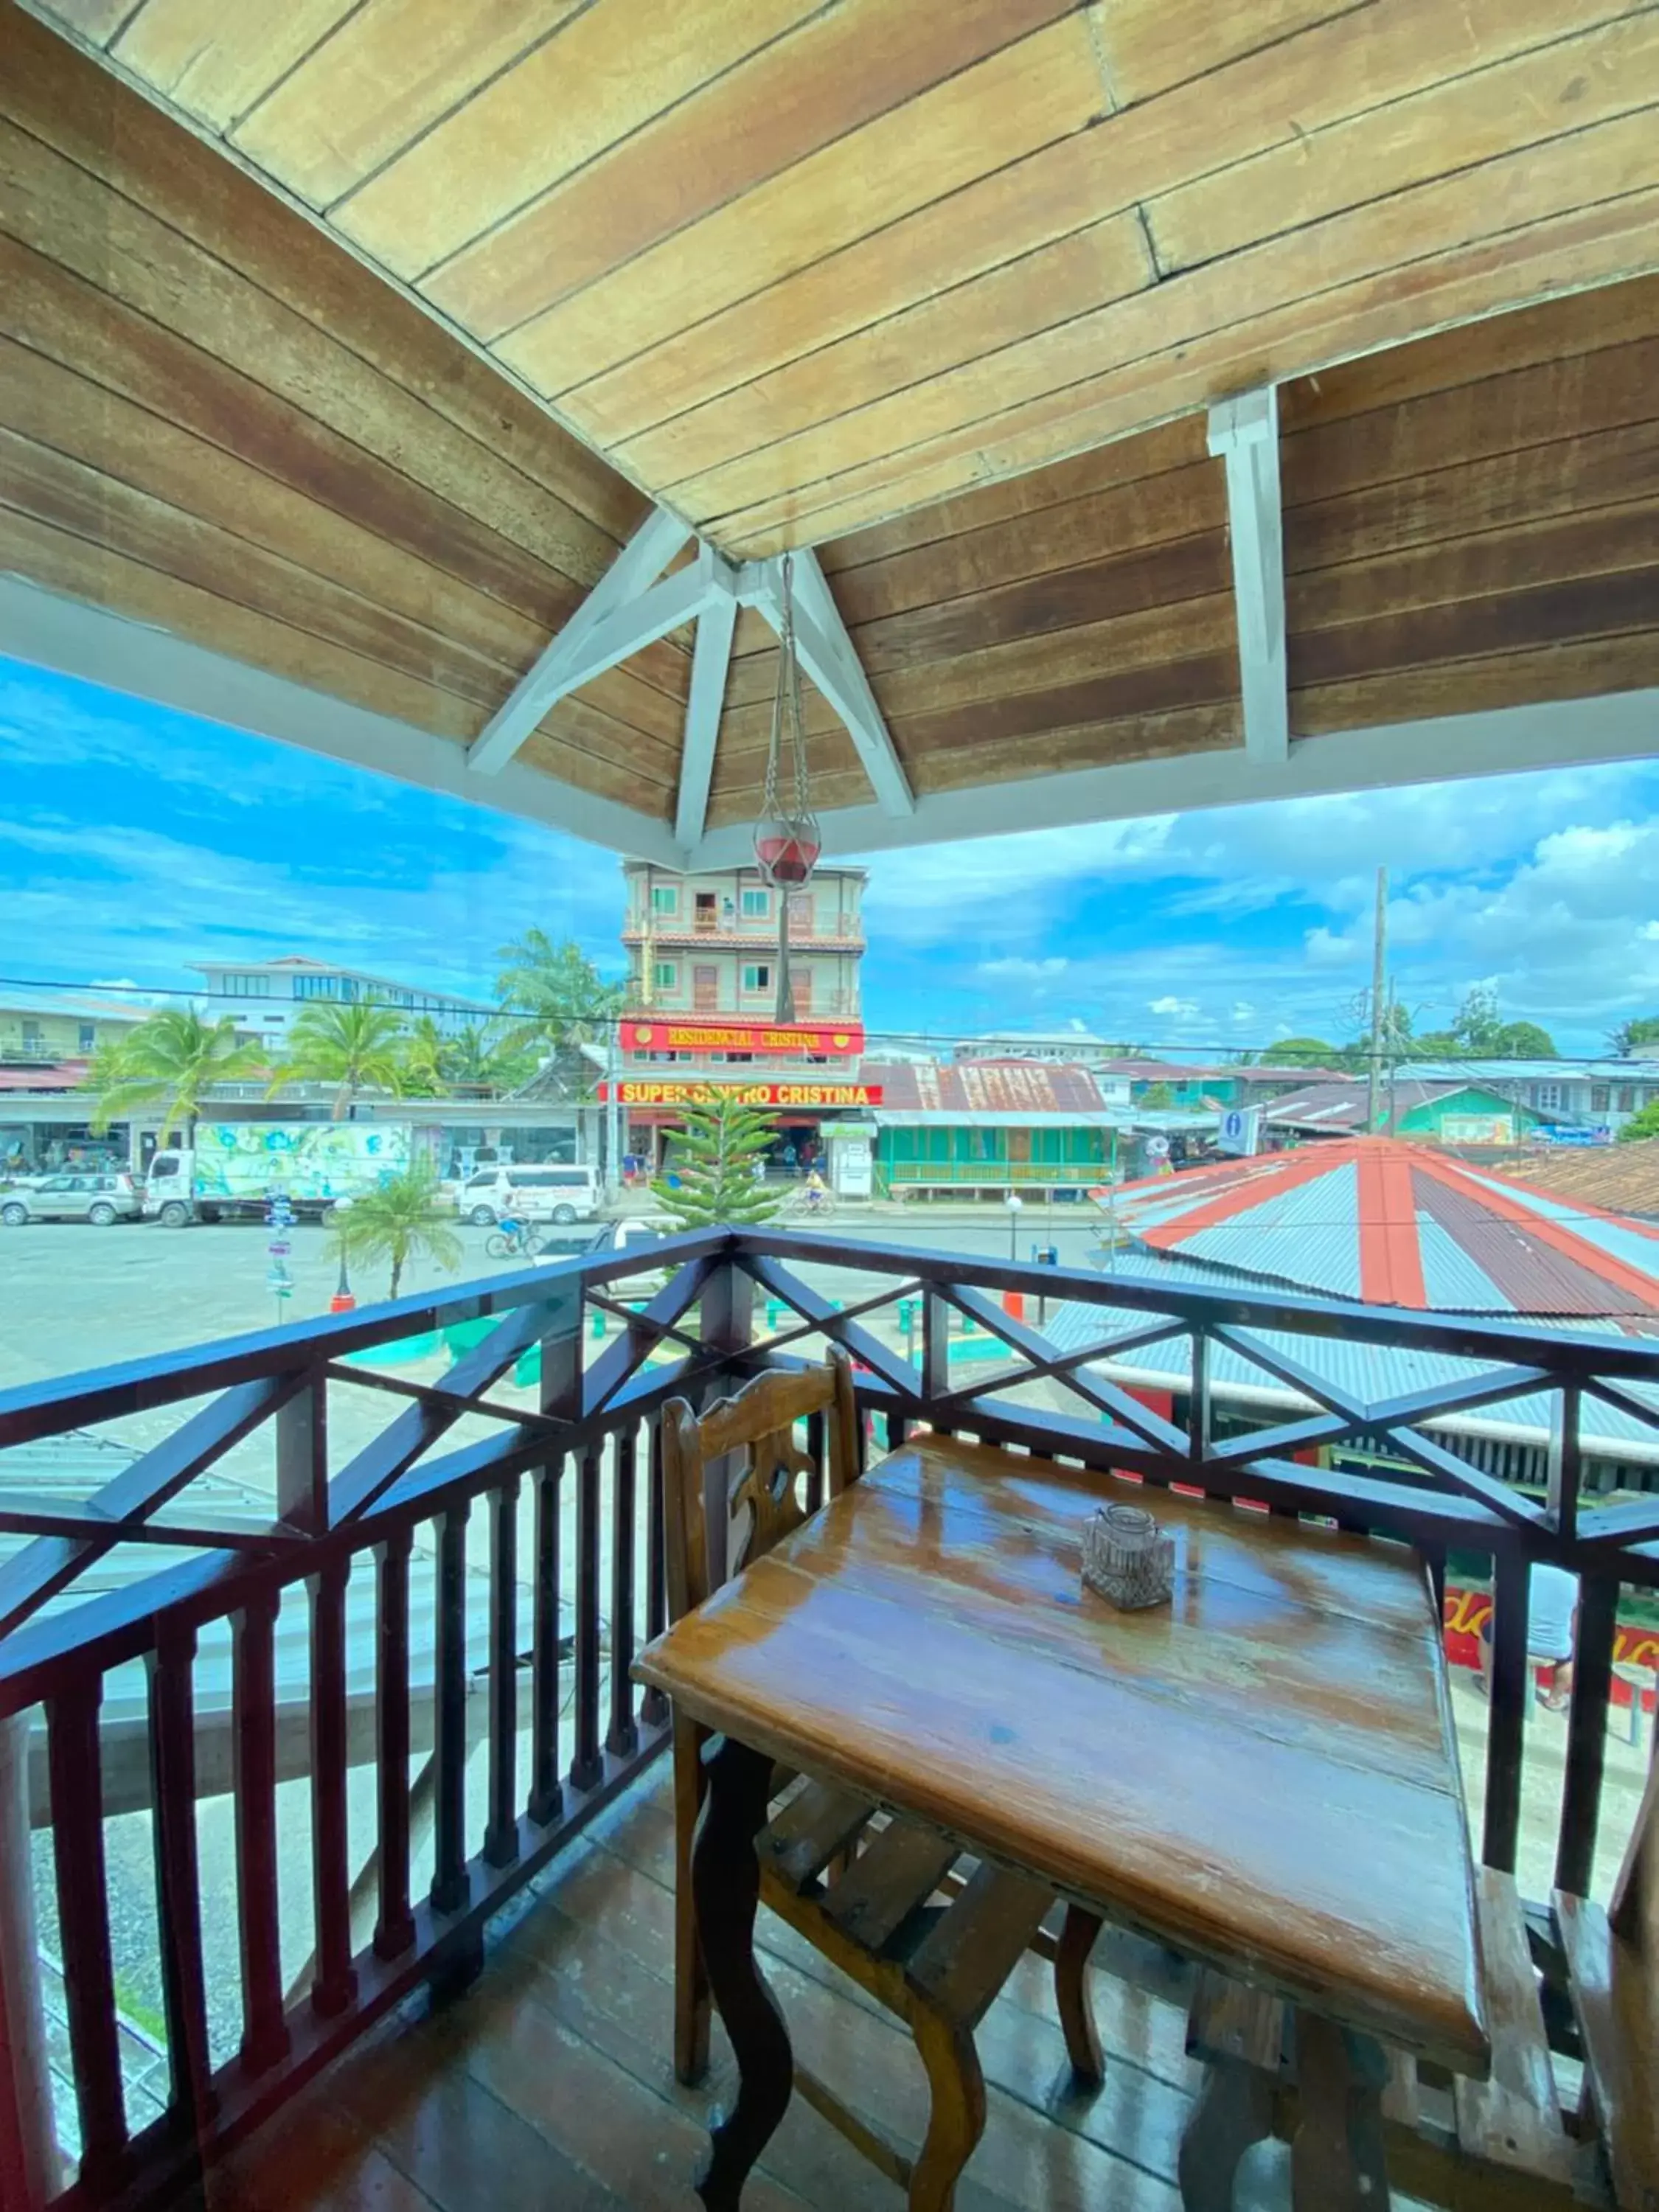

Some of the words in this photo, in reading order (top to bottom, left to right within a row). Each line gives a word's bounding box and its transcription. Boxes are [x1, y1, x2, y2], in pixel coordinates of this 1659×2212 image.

[760, 1031, 821, 1048] CRISTINA
[622, 1083, 686, 1102] SUPER
[776, 1084, 869, 1105] CRISTINA
